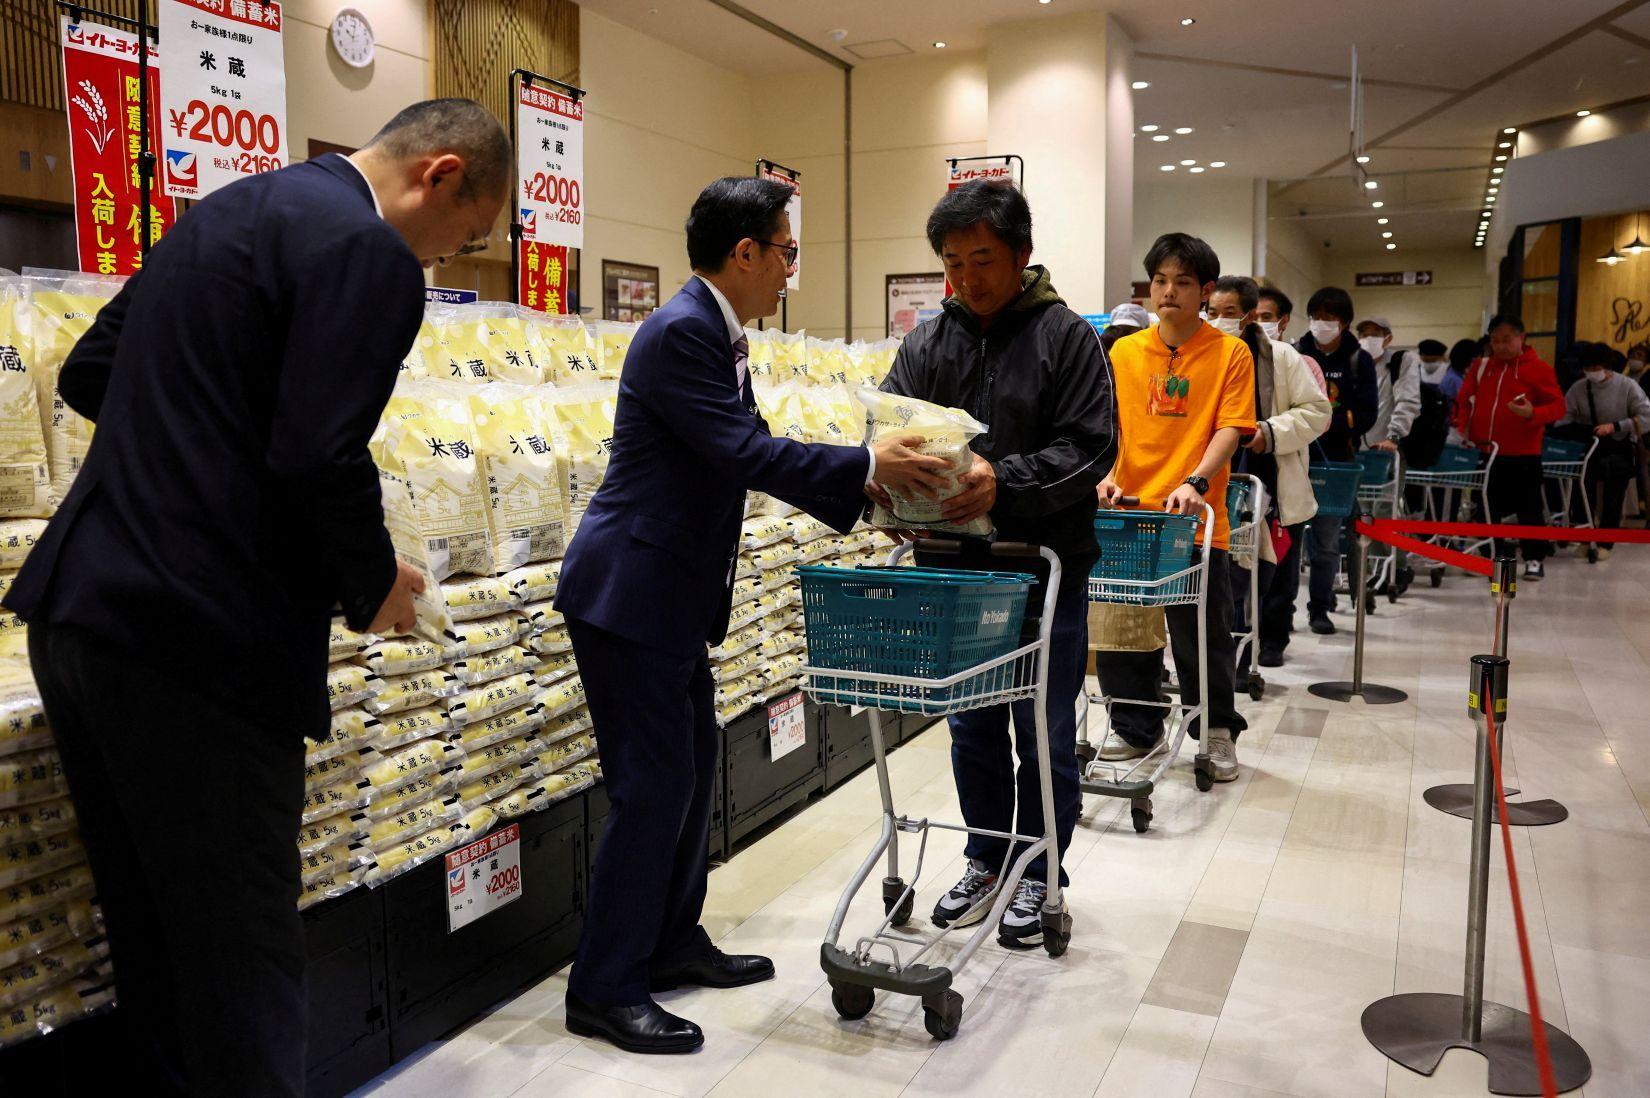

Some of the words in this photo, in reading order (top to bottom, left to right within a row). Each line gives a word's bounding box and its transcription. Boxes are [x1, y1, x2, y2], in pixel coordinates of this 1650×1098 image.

[230, 0, 279, 26] 備蓄米
[190, 19, 253, 45] お一家族様1点限り
[210, 85, 228, 98] 5kg
[521, 86, 556, 110] 随意契約
[169, 99, 280, 155] ¥2000
[213, 157, 230, 170] 税込
[231, 152, 282, 174] ¥2160
[524, 172, 581, 208] ¥2000
[91, 172, 117, 275] 入荷しま
[555, 207, 581, 226] ¥2160
[527, 241, 540, 306] 入荷しま
[417, 716, 432, 726] 5kg
[419, 753, 433, 765] 5kg
[419, 780, 433, 789] 5kg
[419, 808, 433, 819] 5kg
[323, 825, 339, 836] 5kg
[426, 835, 442, 847] 5kg
[450, 841, 488, 869] 随意契約
[485, 865, 519, 896] ¥2000
